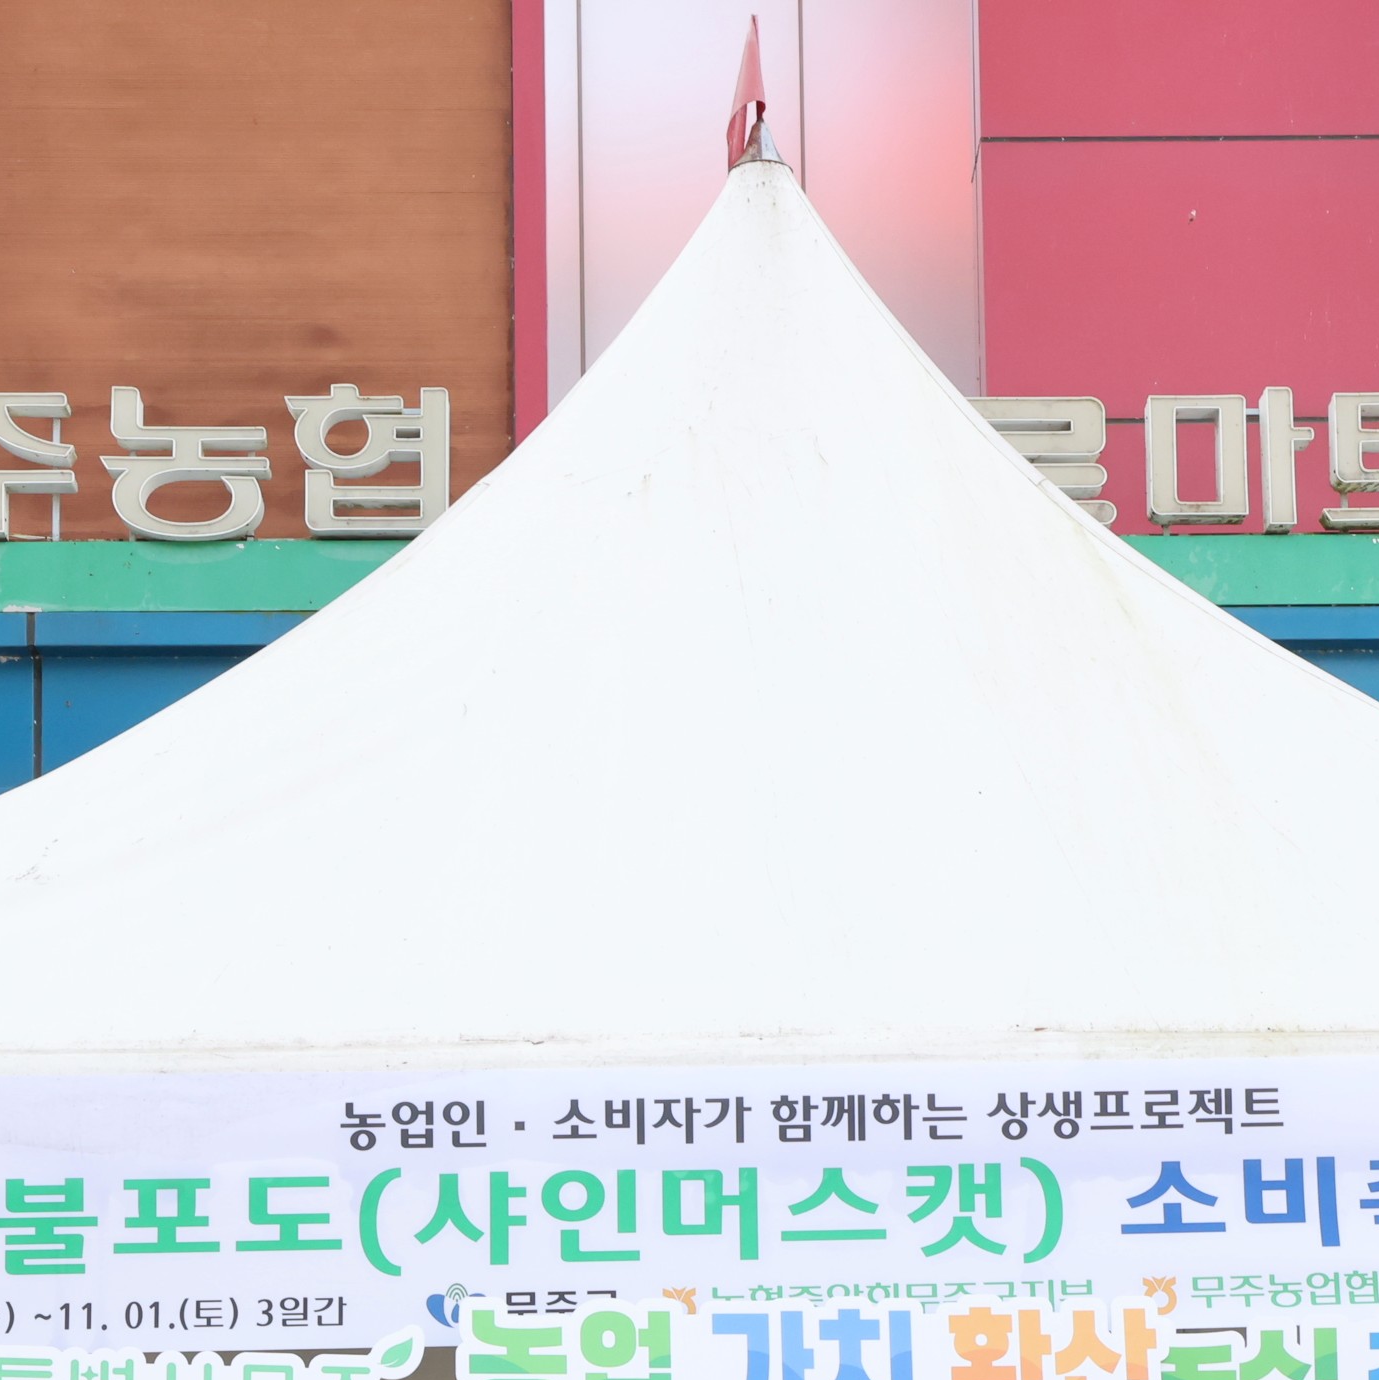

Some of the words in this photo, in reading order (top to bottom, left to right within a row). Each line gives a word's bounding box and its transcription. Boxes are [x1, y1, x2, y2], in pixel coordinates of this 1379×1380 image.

[341, 1101, 486, 1151] 농업인
[552, 1097, 751, 1143] 소비자가
[770, 1093, 966, 1143] 함께하는
[987, 1087, 1284, 1140] 상생프로젝트
[34, 1302, 108, 1333] ~11.
[124, 1298, 239, 1333] 01.(토)
[255, 1296, 347, 1329] 3일간
